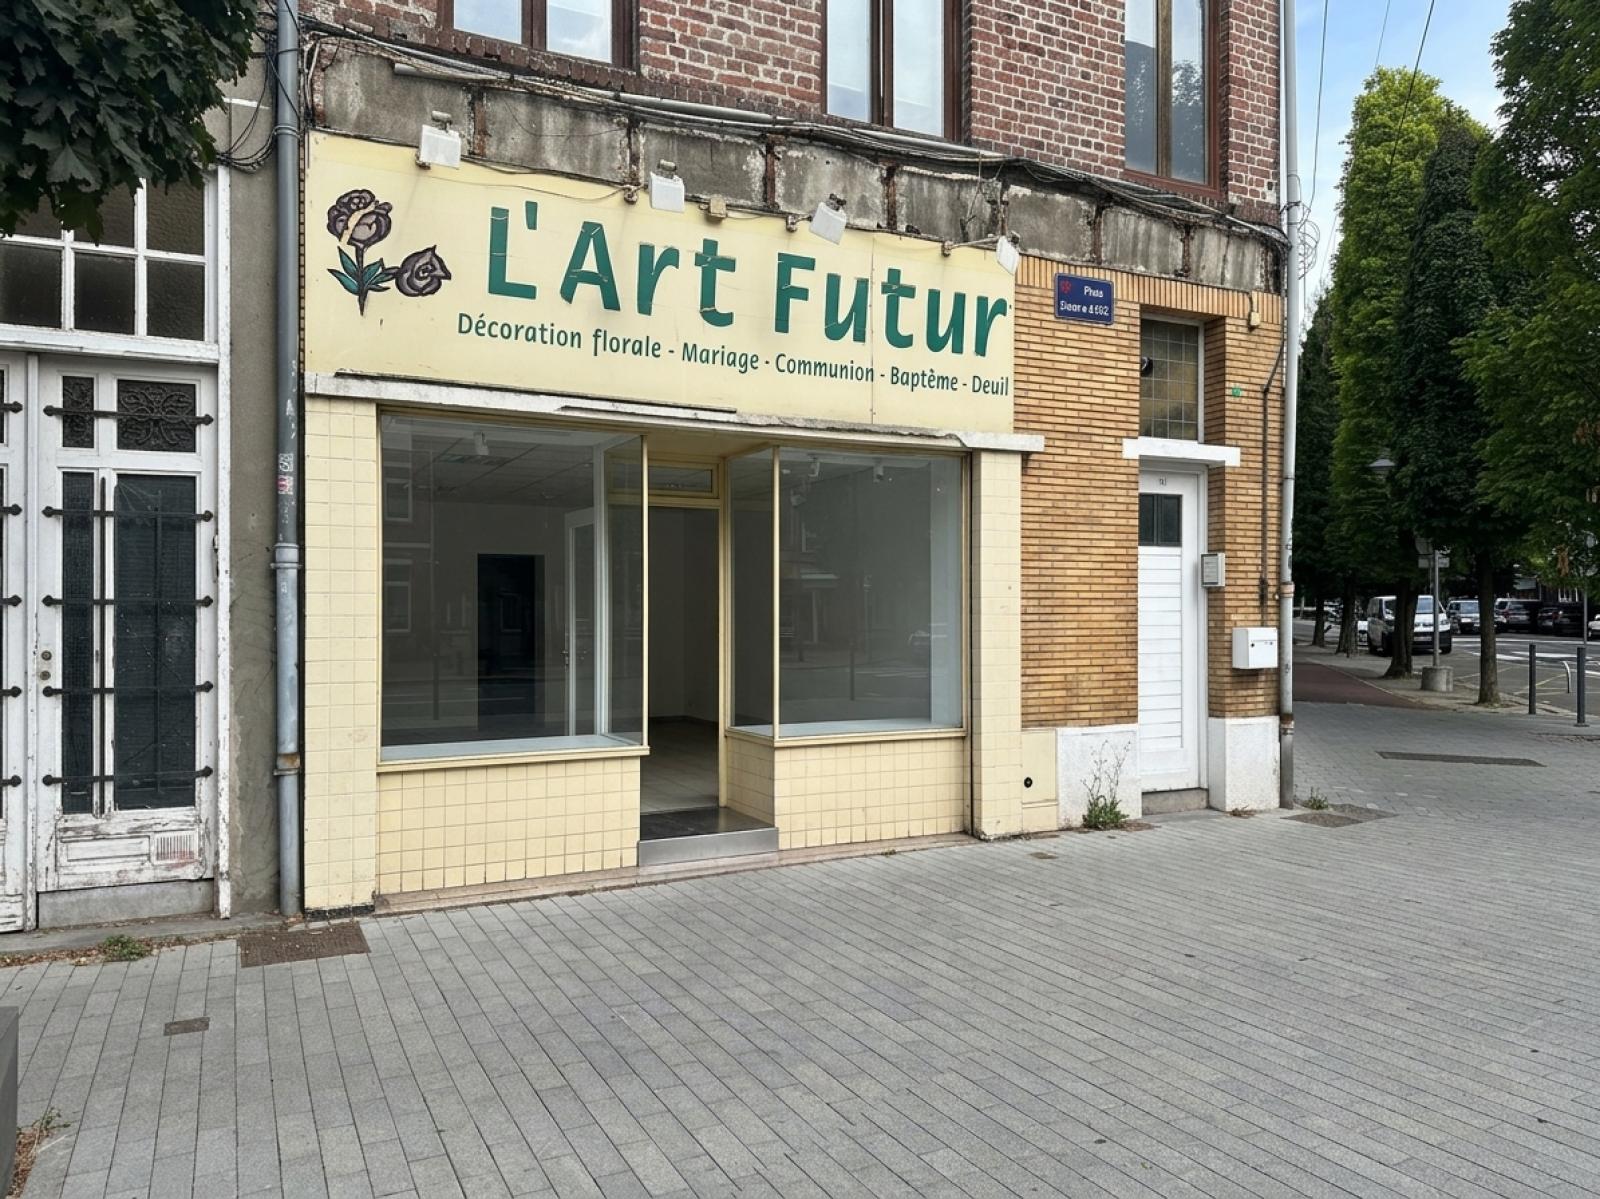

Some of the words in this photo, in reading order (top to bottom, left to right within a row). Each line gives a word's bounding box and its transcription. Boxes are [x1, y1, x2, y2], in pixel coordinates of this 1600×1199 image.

[489, 201, 736, 328] L'Art
[775, 253, 1010, 358] Futur
[458, 313, 582, 348] Décoration
[593, 330, 661, 357] florale
[682, 342, 759, 374] Mariage
[776, 354, 874, 382] Communion
[891, 366, 958, 392] Baptême
[972, 376, 1009, 396] Deuil
